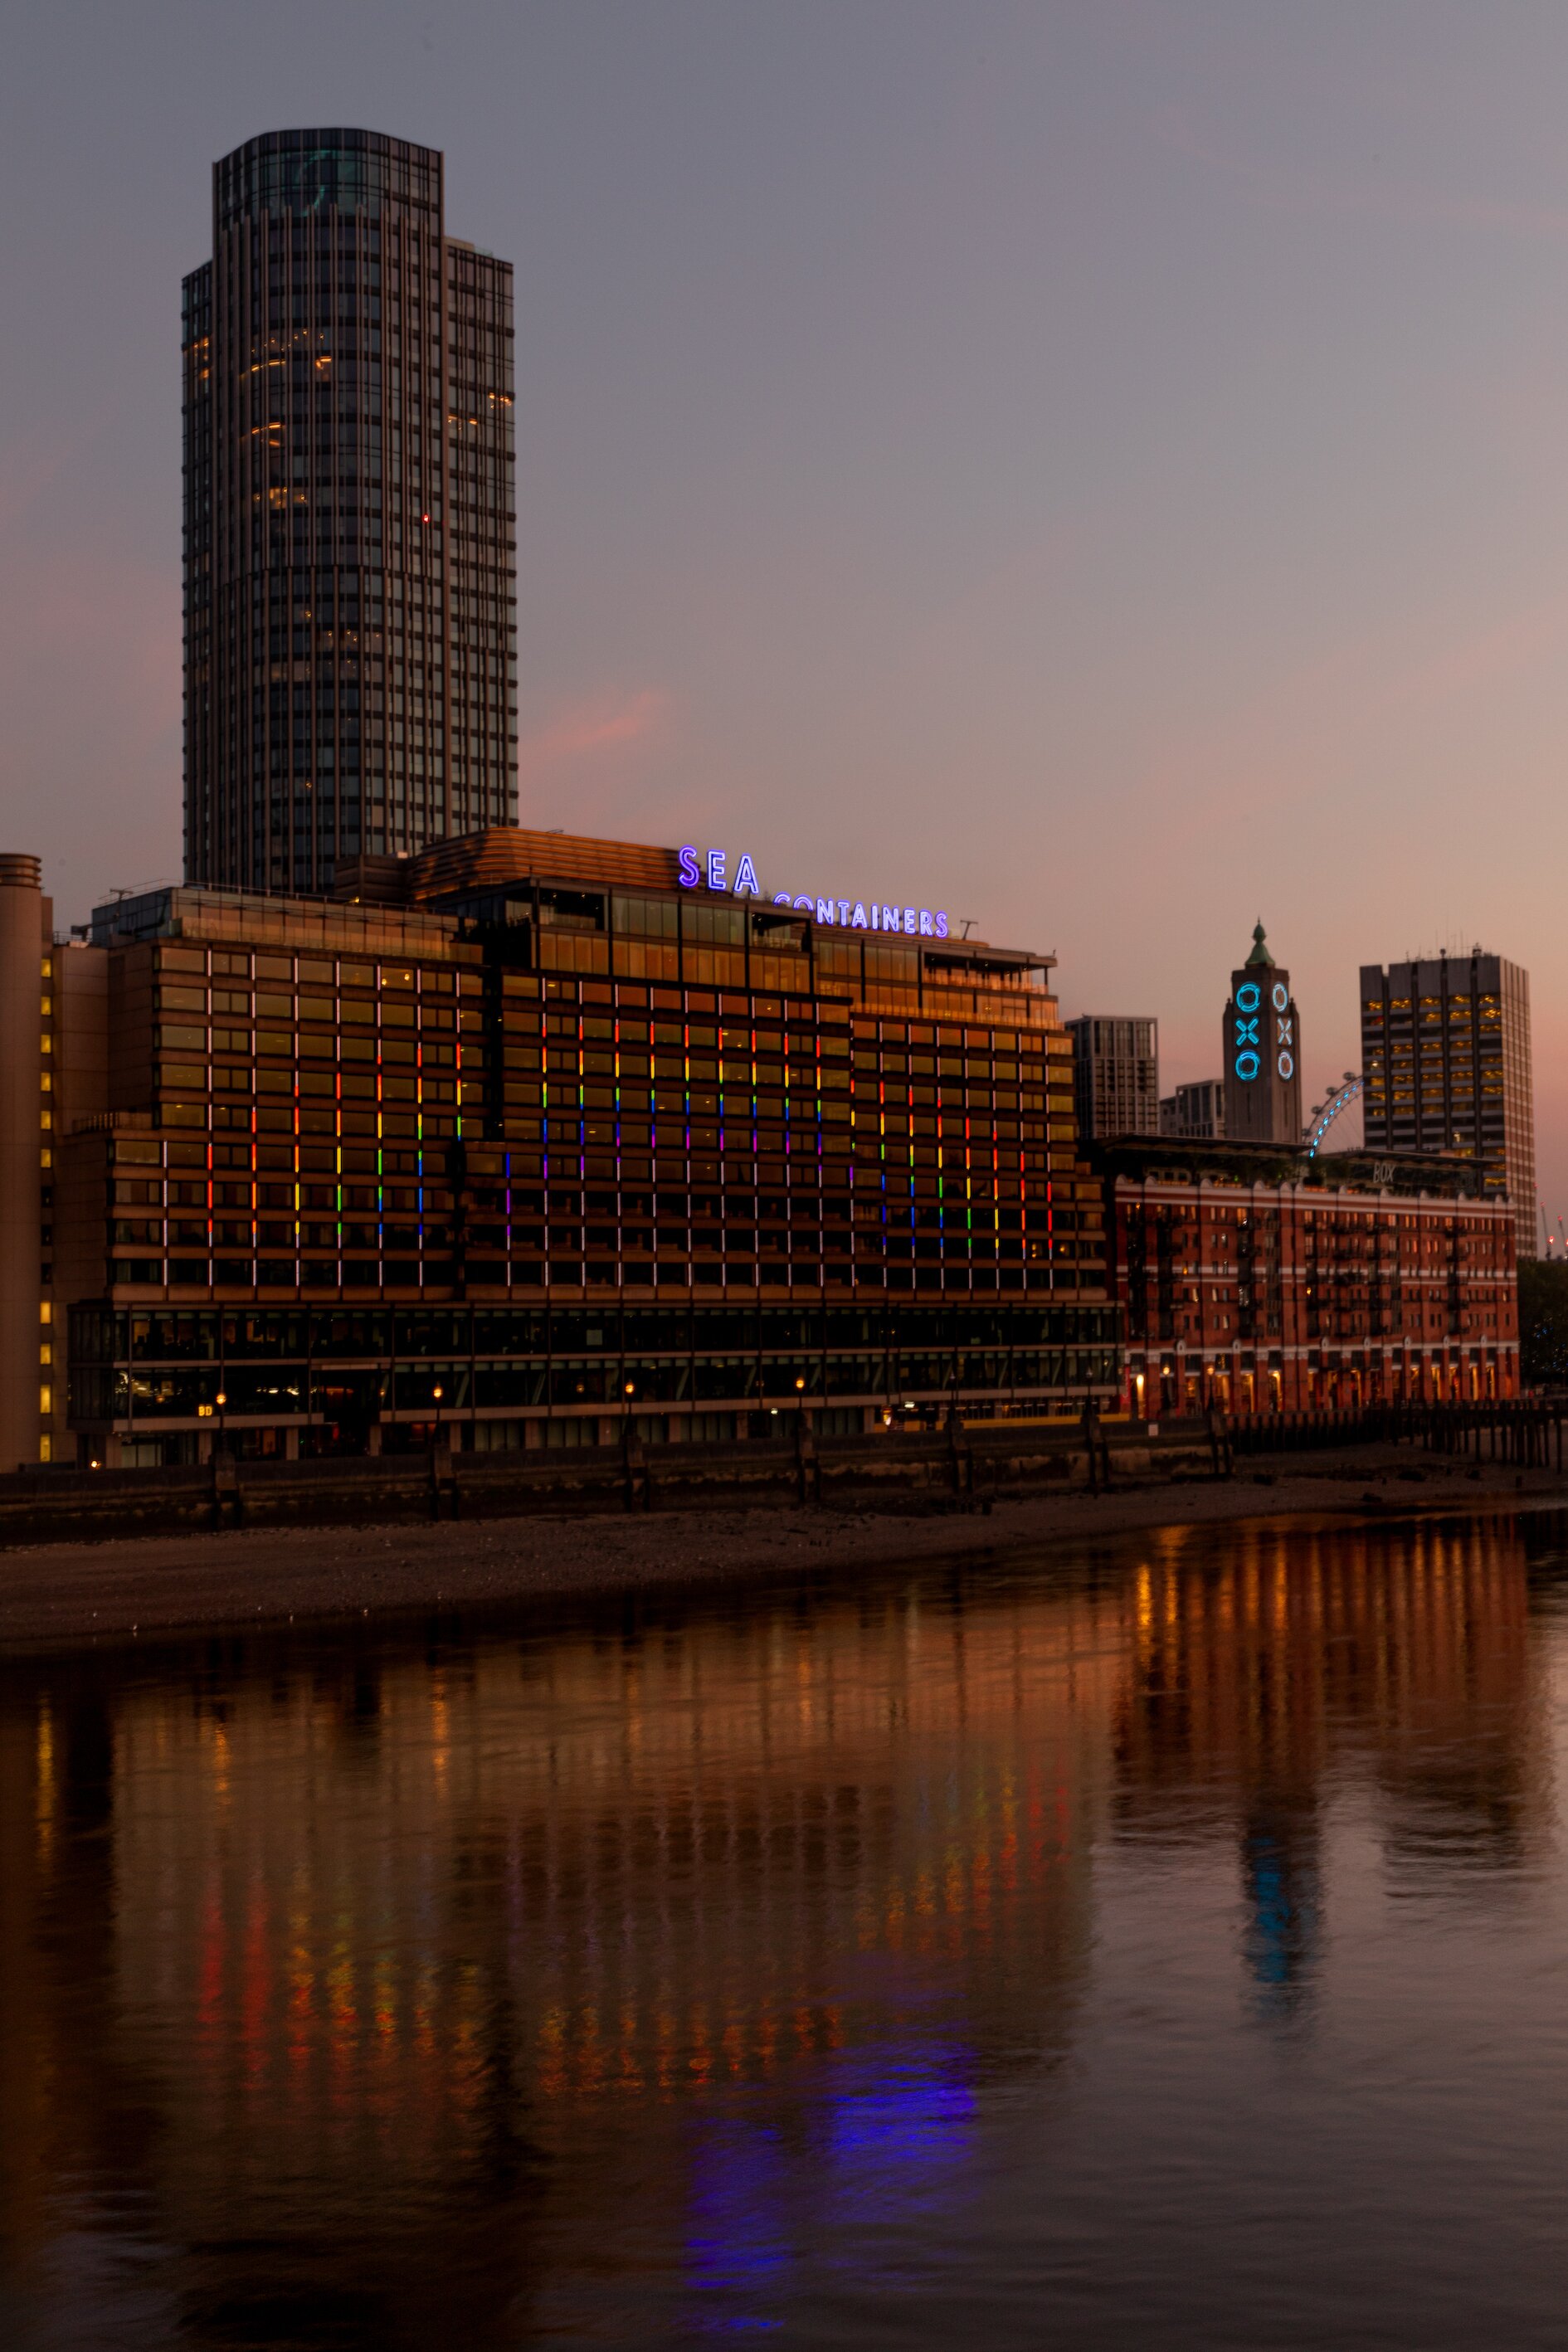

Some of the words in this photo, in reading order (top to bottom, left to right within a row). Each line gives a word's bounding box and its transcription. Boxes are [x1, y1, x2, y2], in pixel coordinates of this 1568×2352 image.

[678, 845, 760, 894] SEA
[1234, 981, 1261, 1082] OXO
[1272, 983, 1293, 1079] OXO
